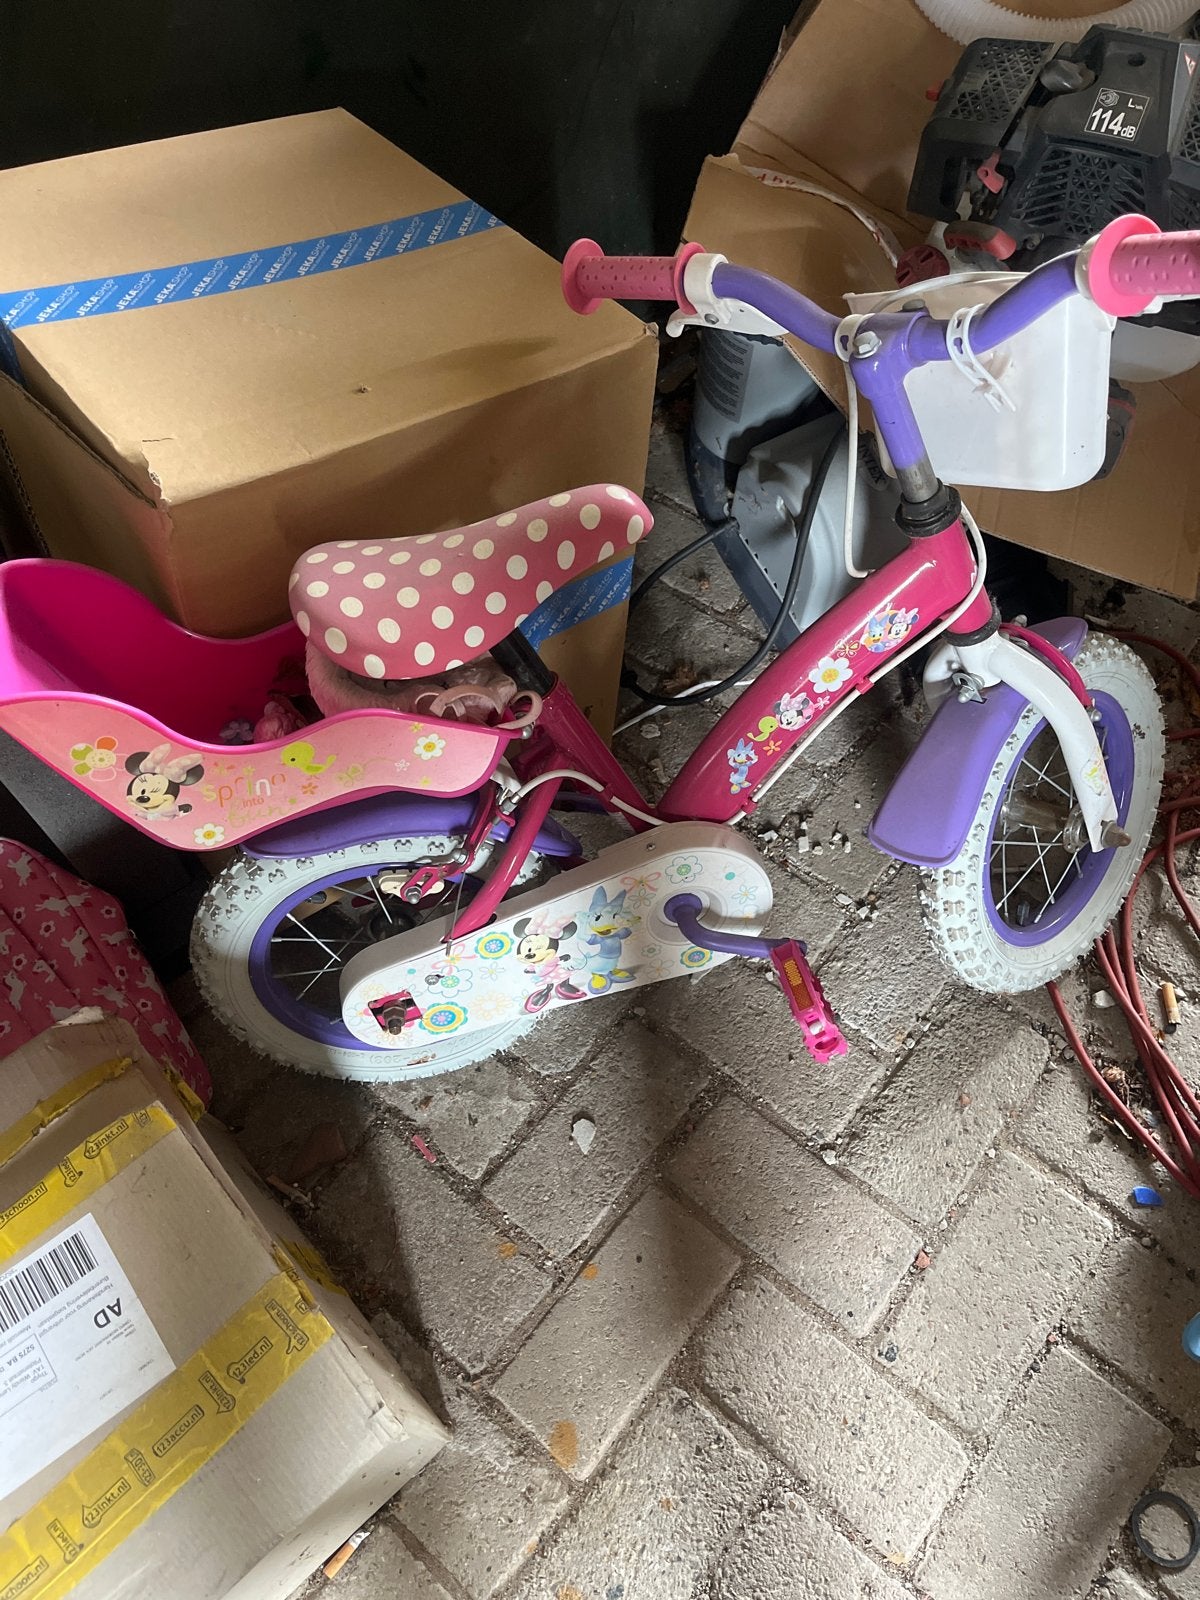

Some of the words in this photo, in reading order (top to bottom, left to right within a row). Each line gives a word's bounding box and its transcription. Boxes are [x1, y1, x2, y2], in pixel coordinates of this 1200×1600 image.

[363, 224, 389, 261] JEKASHOP
[395, 216, 420, 253] JEKASHOP
[427, 208, 450, 245] JEKASHOP
[263, 246, 293, 283] JEKASHOP
[298, 239, 326, 276] JEKASHOP
[330, 232, 358, 269] JEKASHOP
[154, 266, 189, 304] JEKASHOP
[191, 259, 225, 297] JEKASHOP
[227, 253, 259, 290] JEKASHOP
[36, 285, 75, 322] JEKASHOP
[76, 279, 115, 316] JEKASHOP
[116, 273, 152, 310] JEKASHOP
[243, 797, 265, 808] into
[87, 1122, 126, 1155] 123inkt.nl
[94, 1297, 122, 1328] AD
[269, 1301, 305, 1346] 123schoon.nl
[232, 1338, 271, 1378] 123led.nl
[202, 1373, 231, 1410] 123inkt.nl
[156, 1408, 202, 1453] 123accu.nl
[85, 1481, 128, 1524] 123inkt.nl
